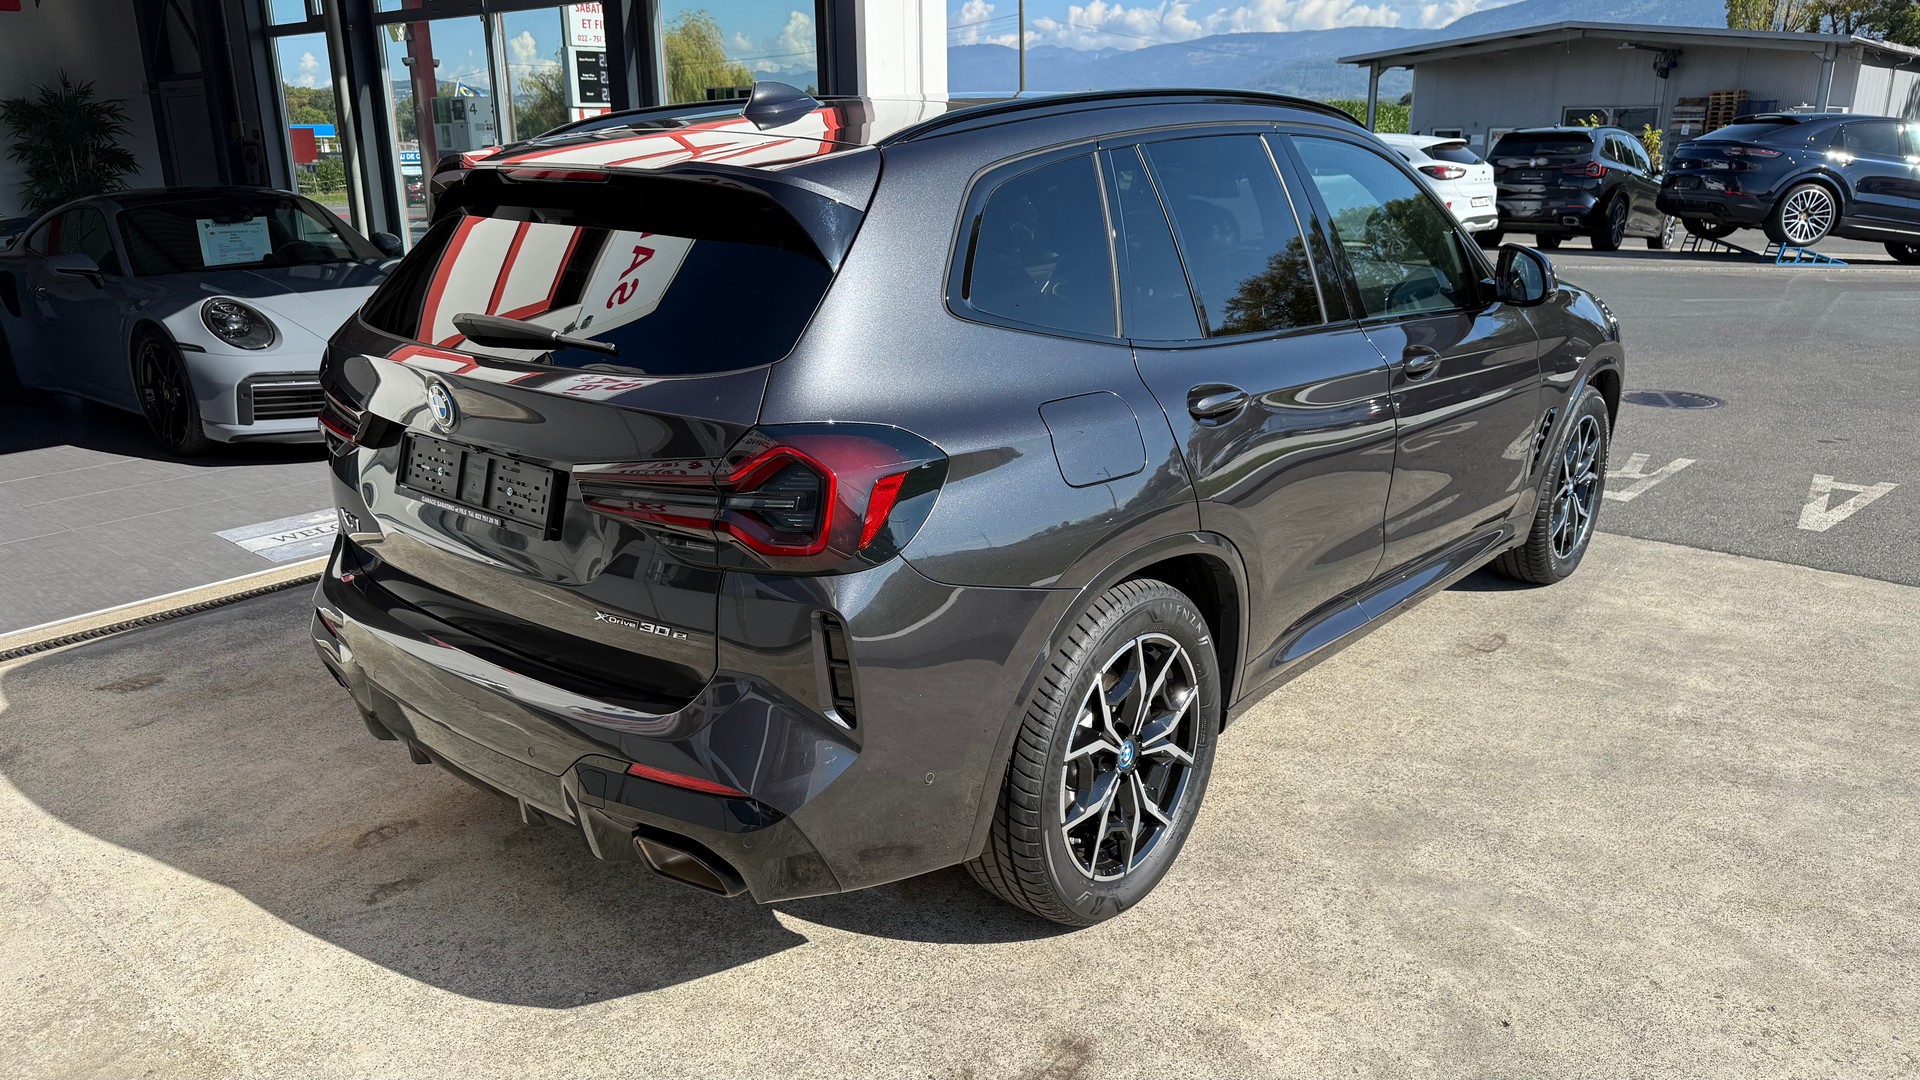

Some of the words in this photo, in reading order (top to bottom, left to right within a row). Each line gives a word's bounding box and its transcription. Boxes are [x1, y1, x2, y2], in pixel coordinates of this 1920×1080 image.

[581, 19, 592, 29] ET
[577, 34, 588, 42] 022
[593, 35, 602, 43] 751
[469, 103, 477, 115] 4
[421, 496, 437, 506] GARAGE
